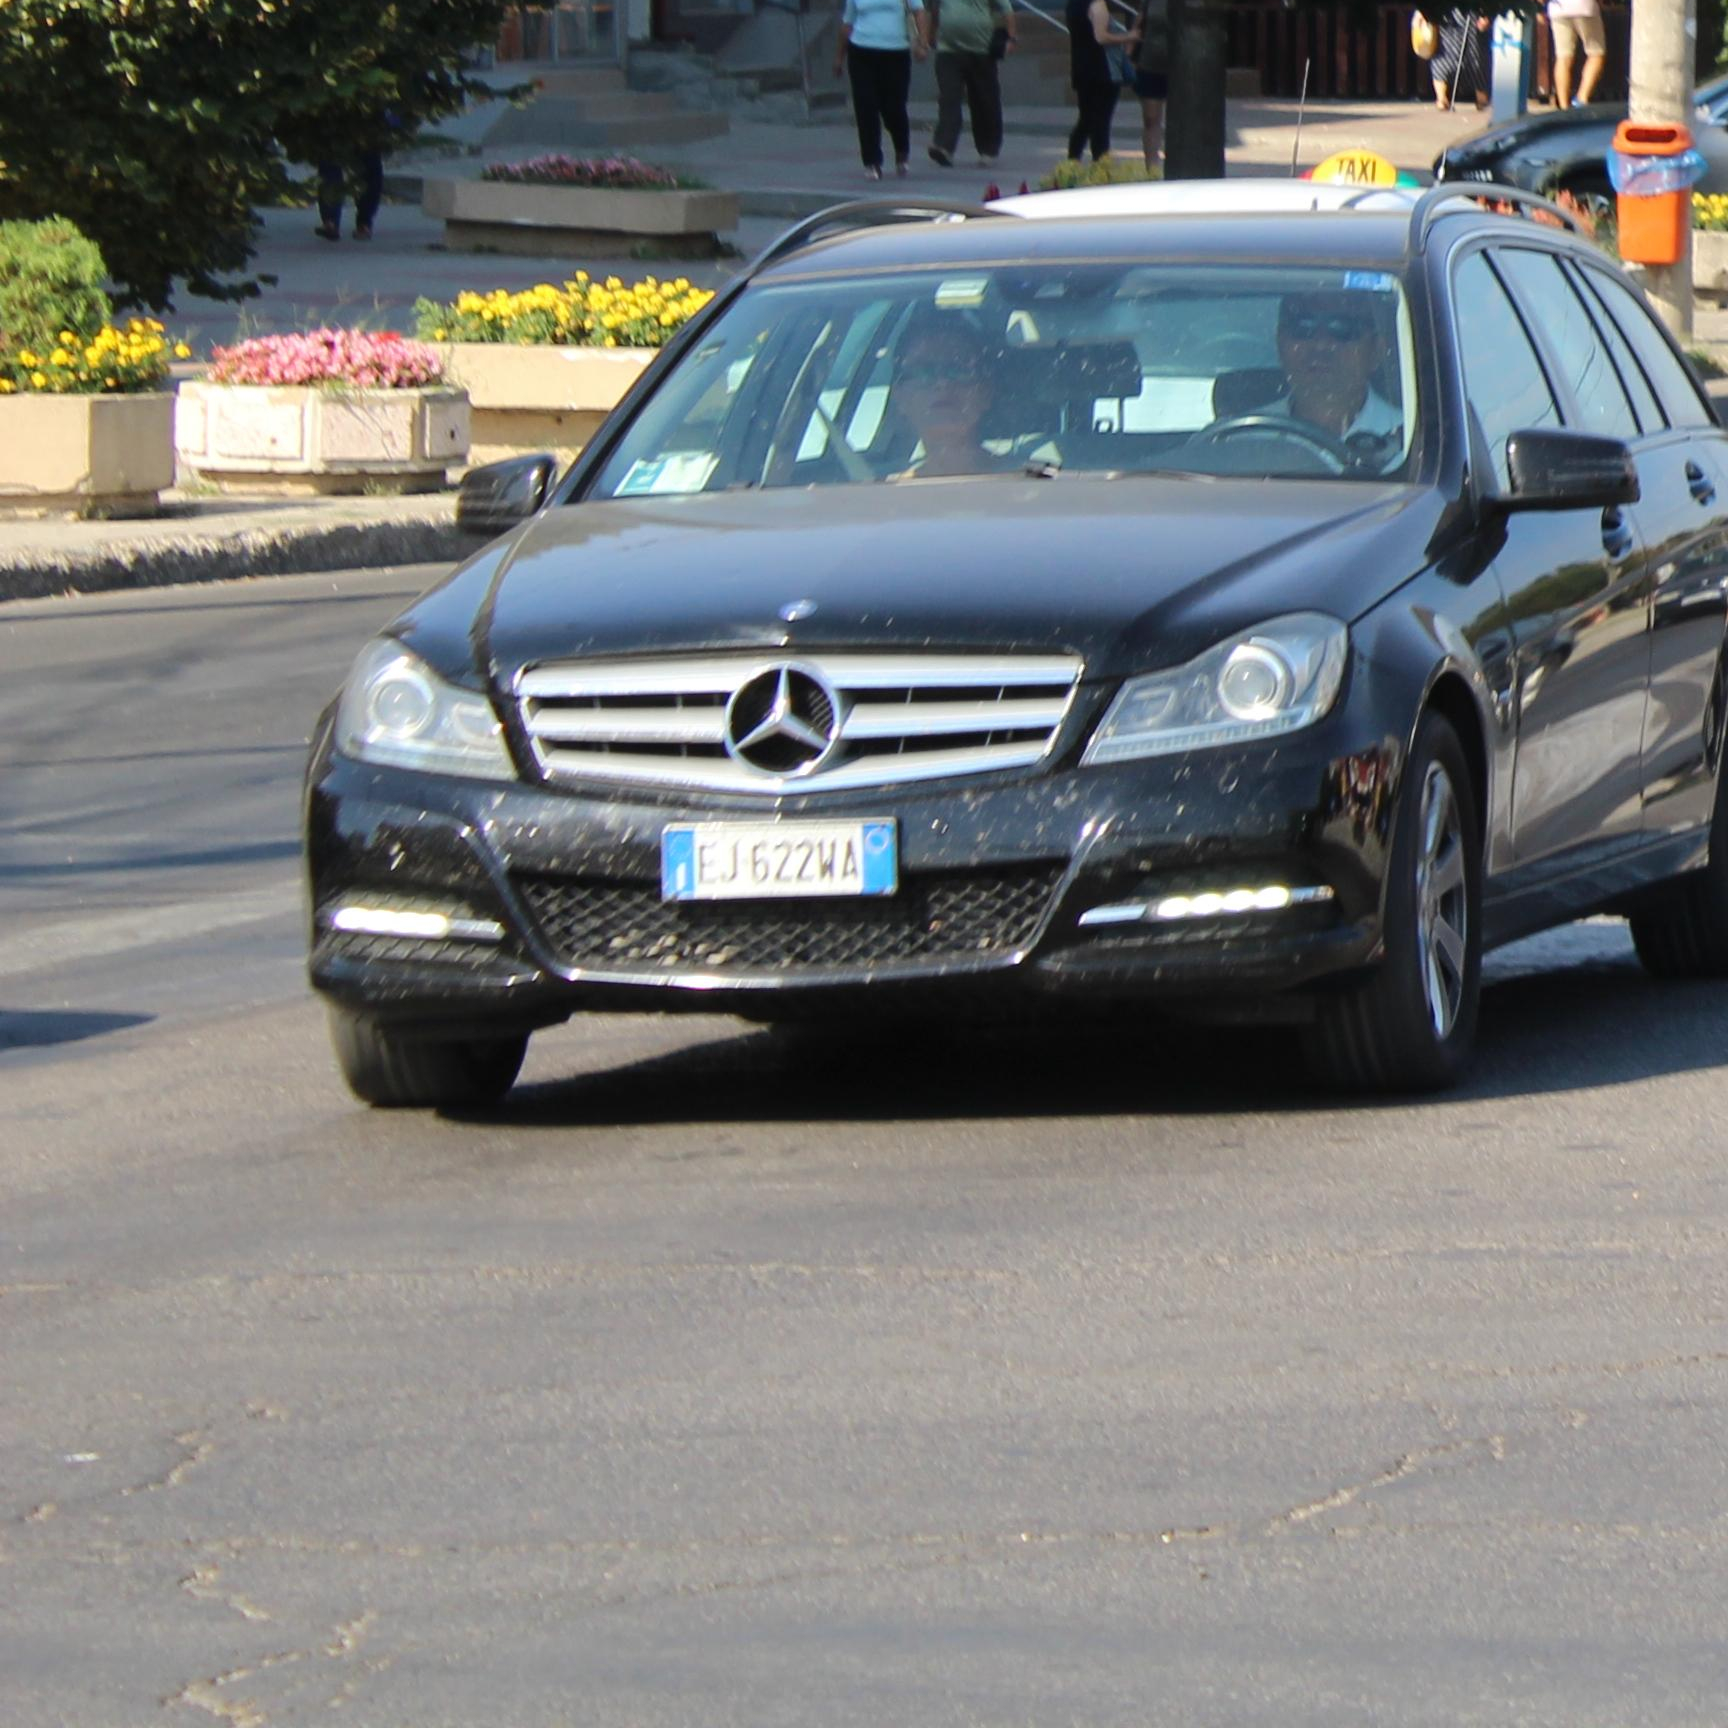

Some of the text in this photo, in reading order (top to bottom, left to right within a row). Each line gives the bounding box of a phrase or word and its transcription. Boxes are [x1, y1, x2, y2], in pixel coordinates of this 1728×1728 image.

[1336, 158, 1377, 184] TAXI
[698, 836, 860, 885] EJ 622WA
